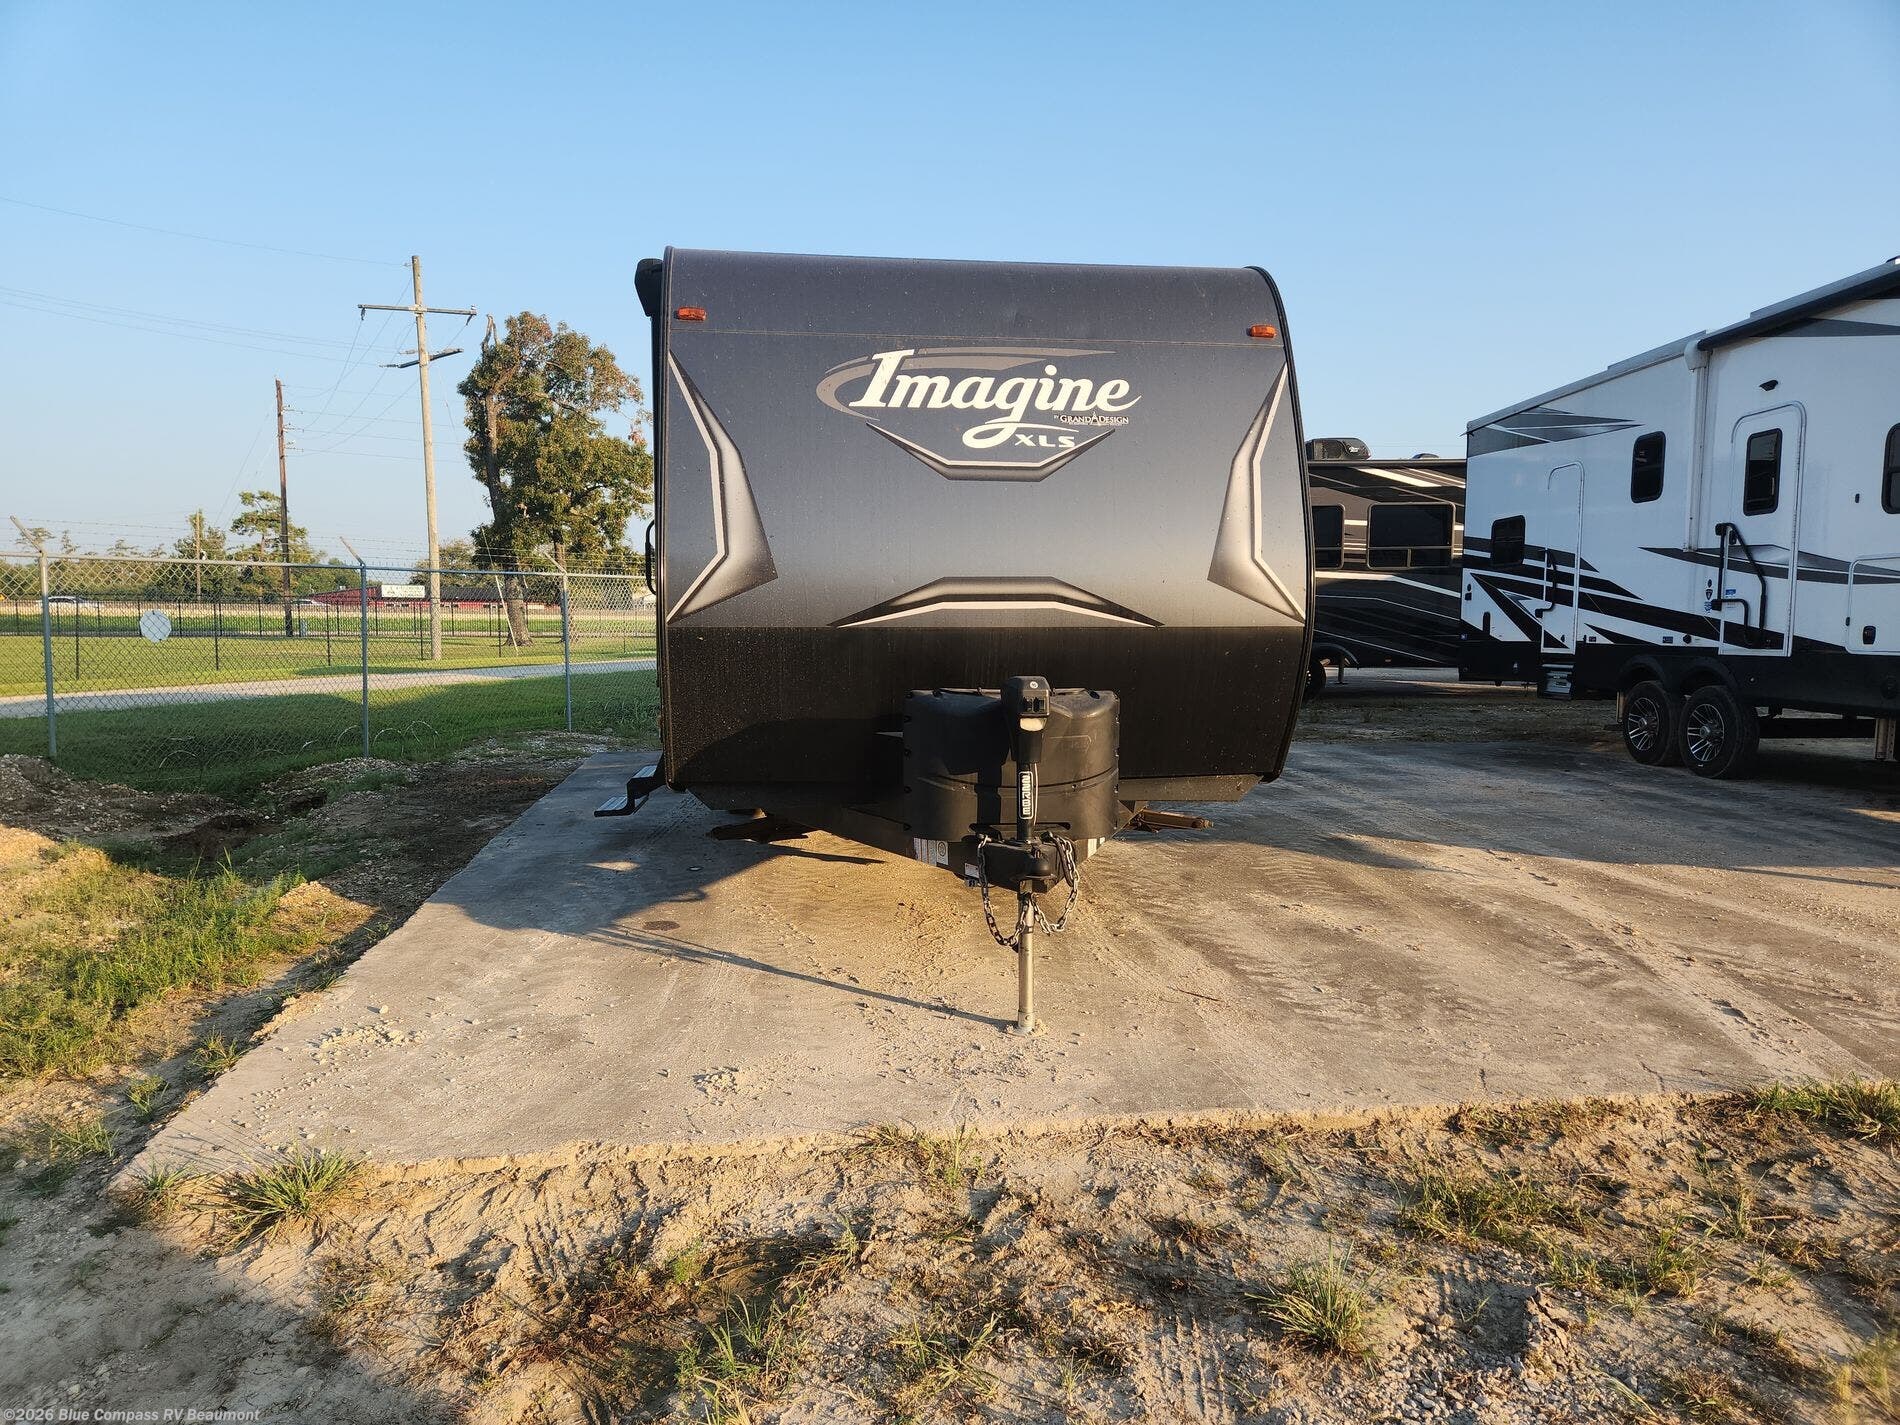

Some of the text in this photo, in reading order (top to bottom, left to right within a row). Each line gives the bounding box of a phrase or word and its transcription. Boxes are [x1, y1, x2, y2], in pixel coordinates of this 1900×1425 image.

[849, 349, 1142, 449] Imagine
[1060, 415, 1091, 423] GRAND
[1098, 415, 1129, 424] DESIGN
[1014, 433, 1075, 448] XLS
